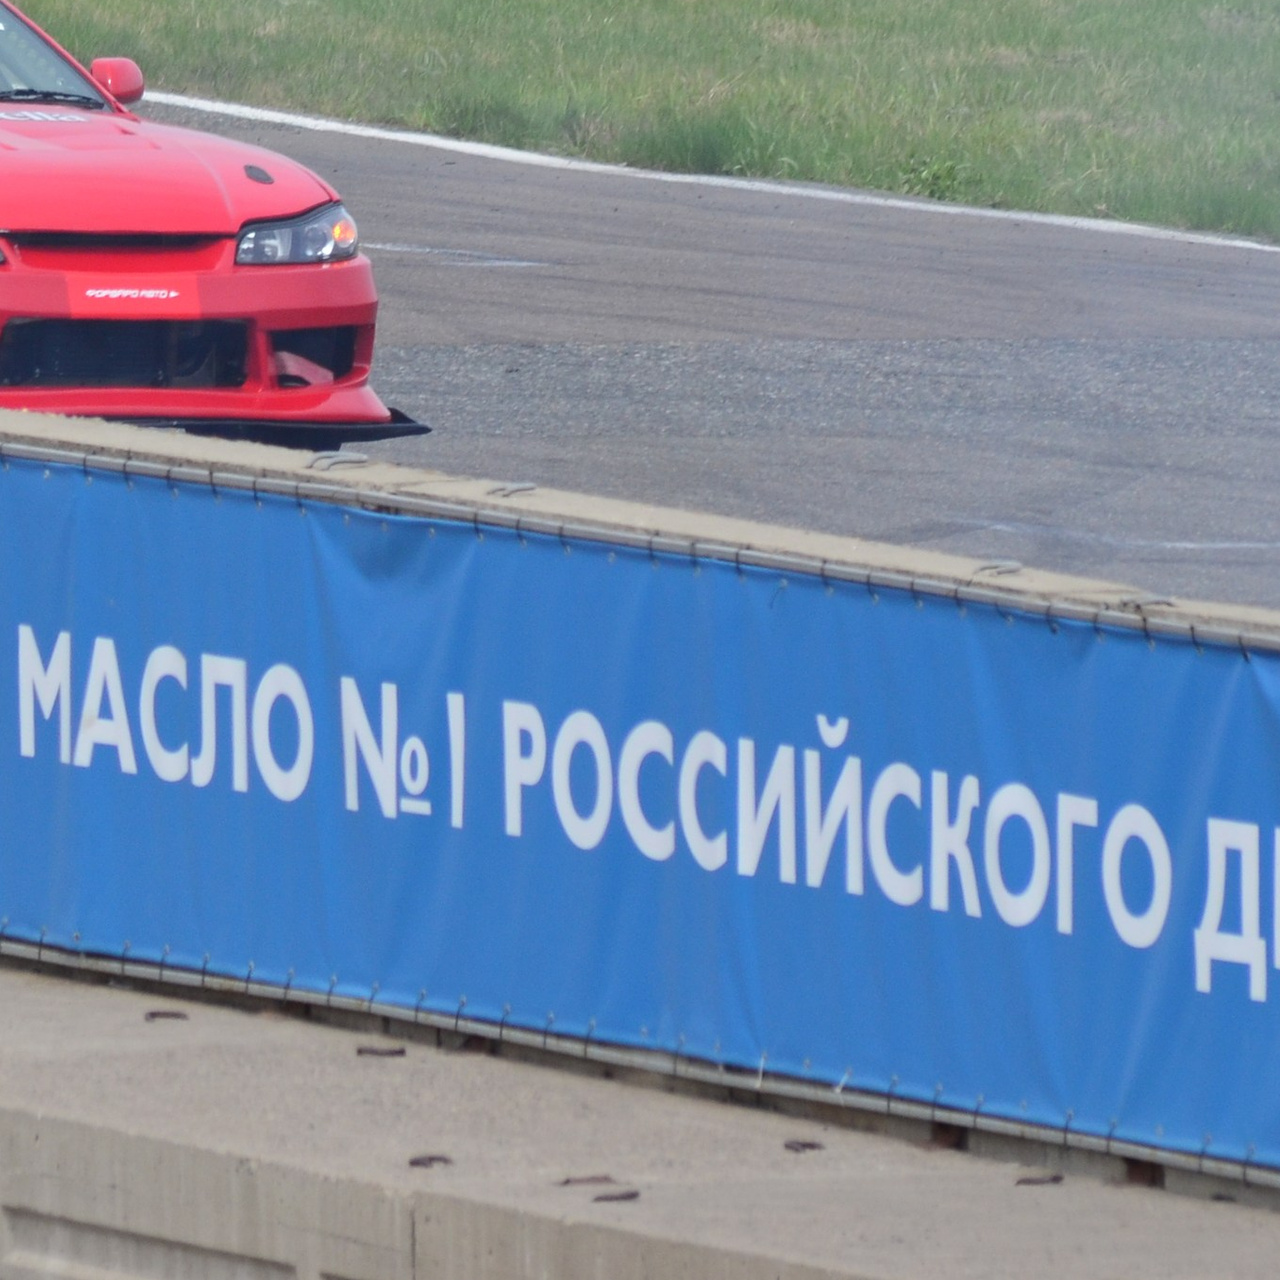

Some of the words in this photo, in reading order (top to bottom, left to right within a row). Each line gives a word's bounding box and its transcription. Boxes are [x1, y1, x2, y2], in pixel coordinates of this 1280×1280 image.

[17, 623, 315, 802] МАСЛО
[501, 694, 1173, 950] РОССИЙСКОГО
[1193, 816, 1280, 1003] Д
